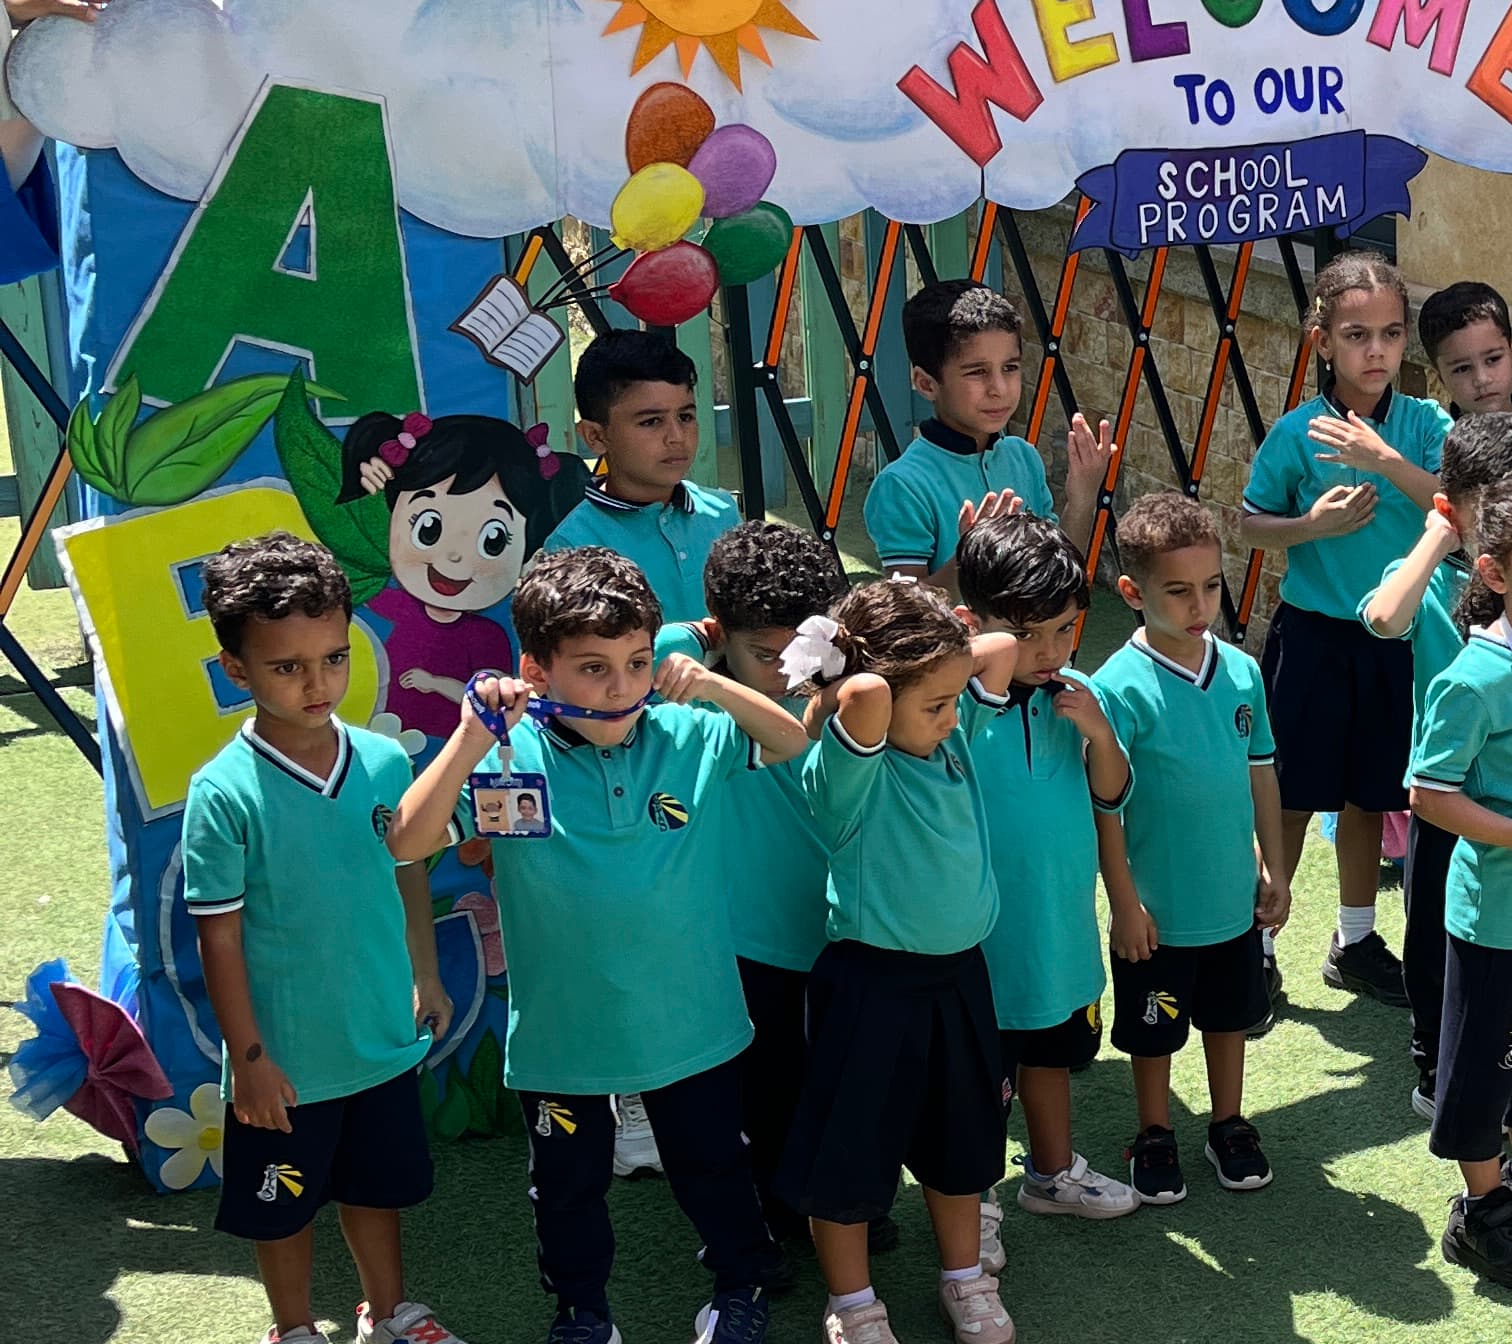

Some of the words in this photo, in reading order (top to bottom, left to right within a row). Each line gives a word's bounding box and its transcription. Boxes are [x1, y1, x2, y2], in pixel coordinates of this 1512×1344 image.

[1174, 73, 1235, 126] TO
[1254, 65, 1345, 115] OUR
[1157, 148, 1308, 200] SCHOOL
[1139, 185, 1347, 244] PROGRAM
[103, 75, 426, 426] A
